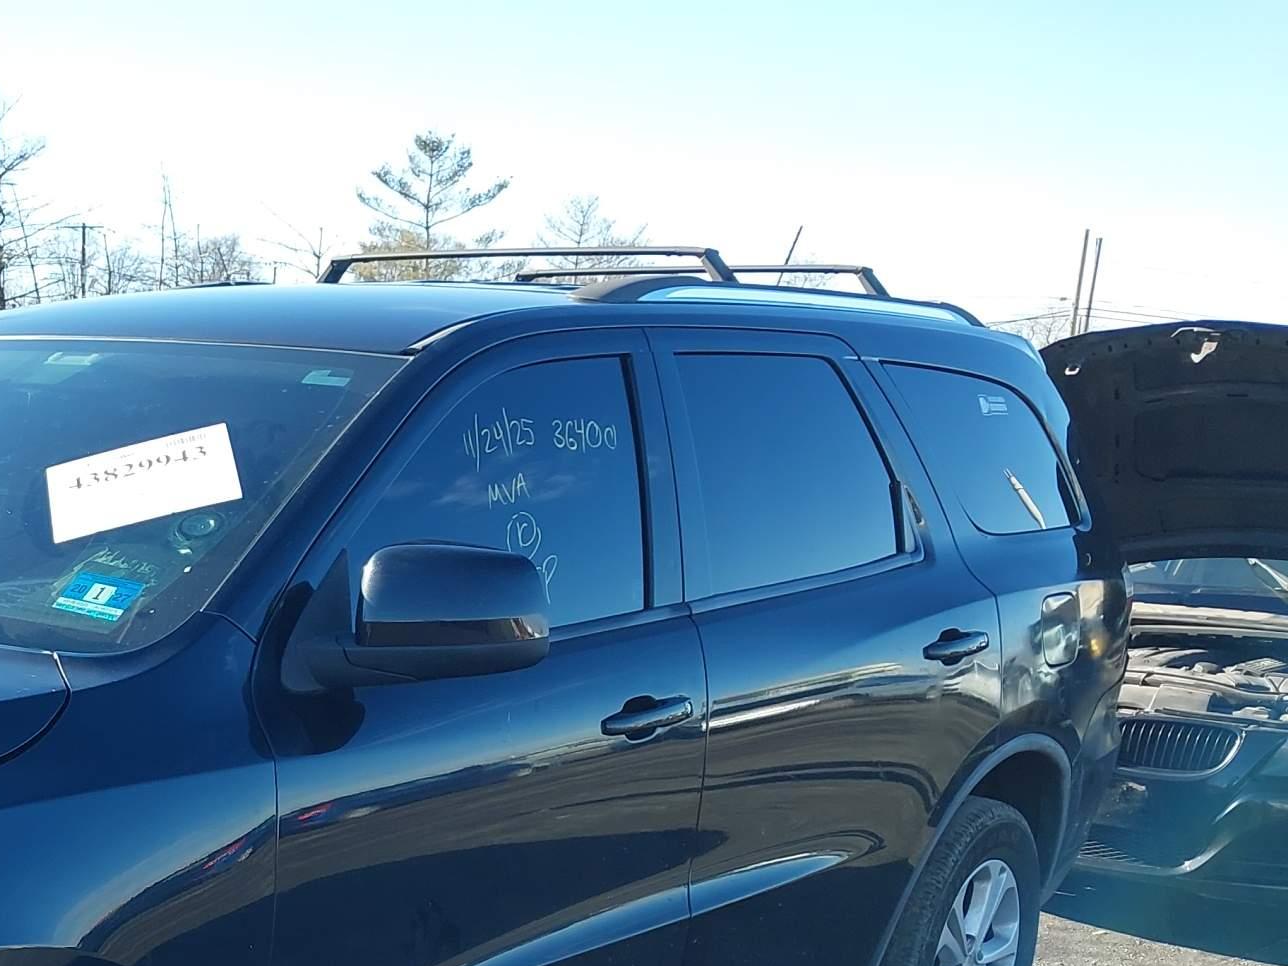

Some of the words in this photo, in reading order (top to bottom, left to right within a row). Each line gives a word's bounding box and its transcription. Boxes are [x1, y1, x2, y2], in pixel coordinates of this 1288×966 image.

[462, 407, 536, 472] 11/24/25
[551, 418, 617, 453] 36400
[68, 445, 207, 489] 43829943
[487, 472, 531, 509] MVA
[70, 583, 87, 594] 20
[91, 586, 106, 600] 1
